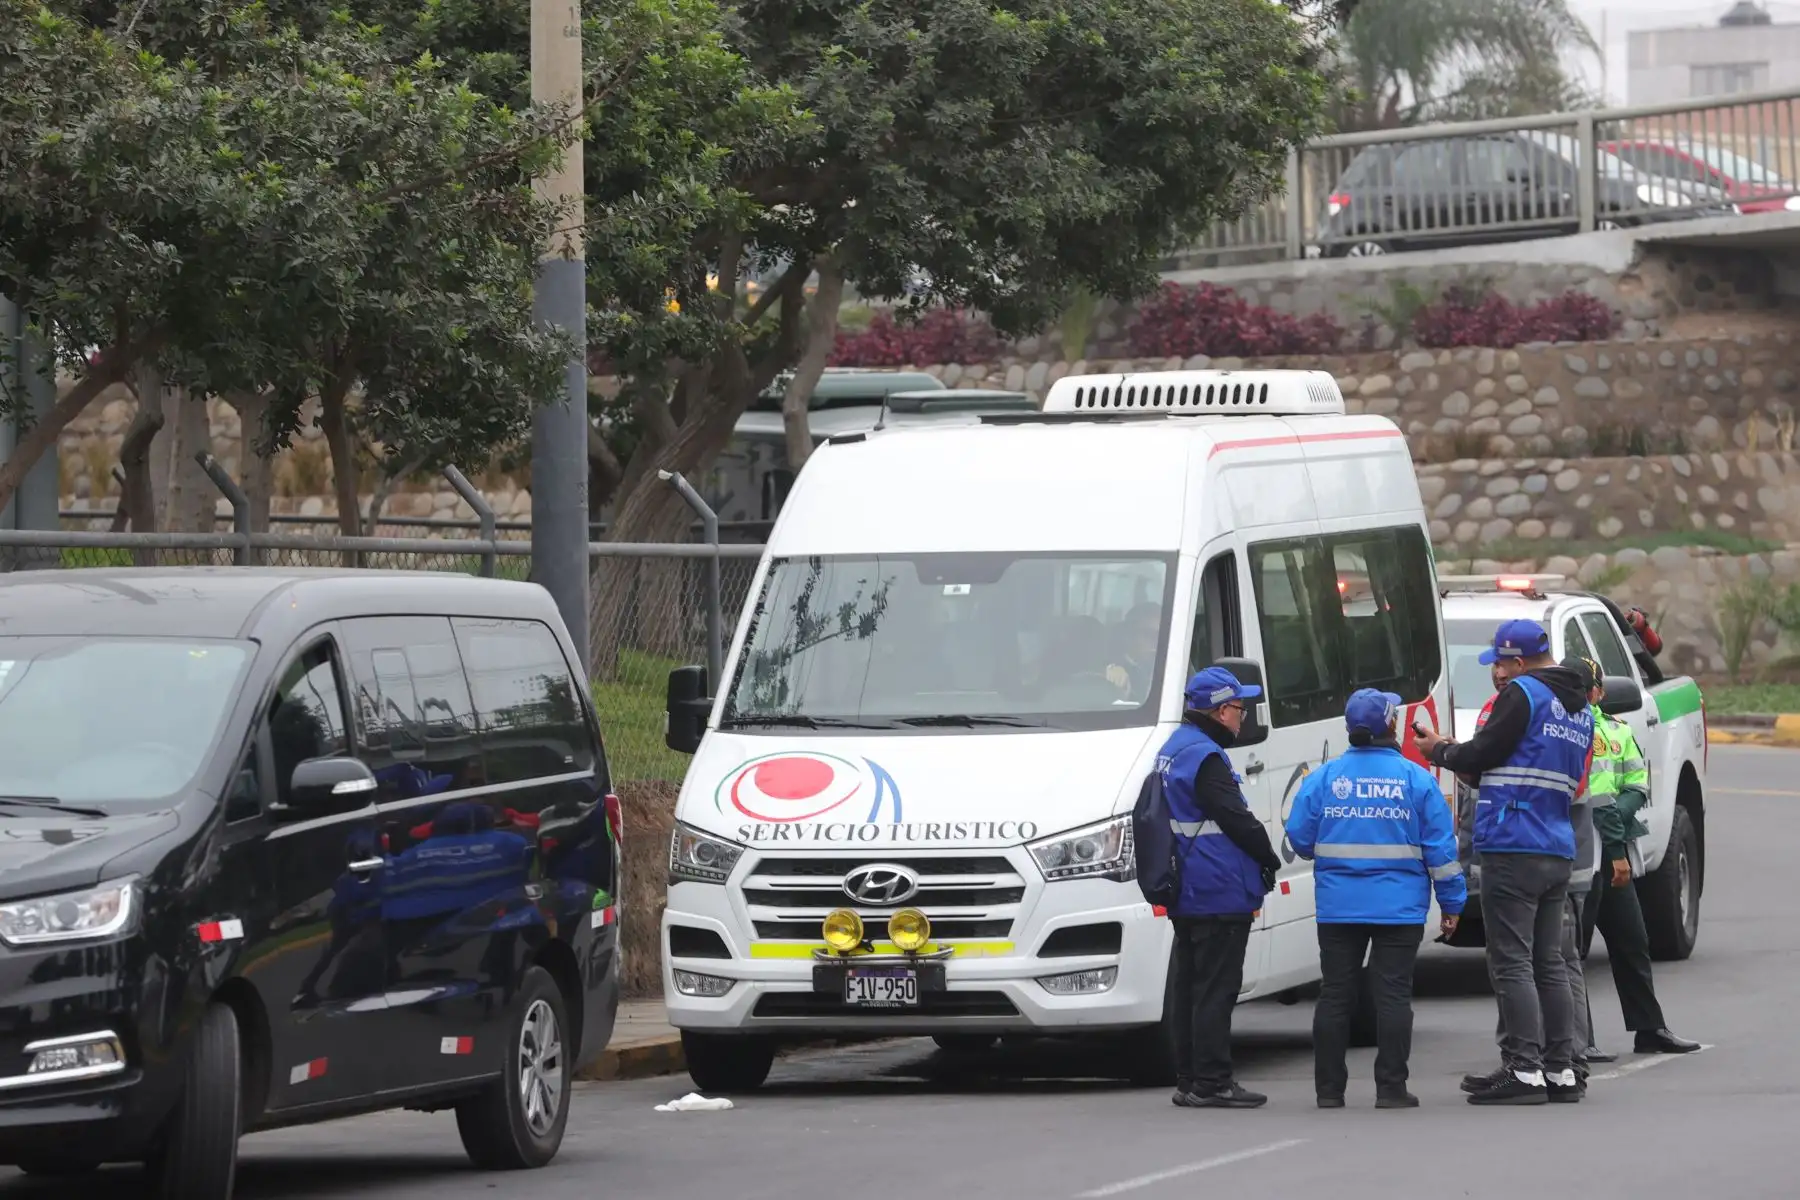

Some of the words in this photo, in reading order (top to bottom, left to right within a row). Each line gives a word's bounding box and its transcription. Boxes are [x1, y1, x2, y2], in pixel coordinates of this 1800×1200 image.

[1356, 784, 1404, 799] LIMA
[1324, 805, 1410, 820] FISCALIZACIÓN
[736, 822, 881, 843] SERVICIO
[887, 820, 1038, 842] TURISTICO
[846, 977, 916, 1000] F1V-950
